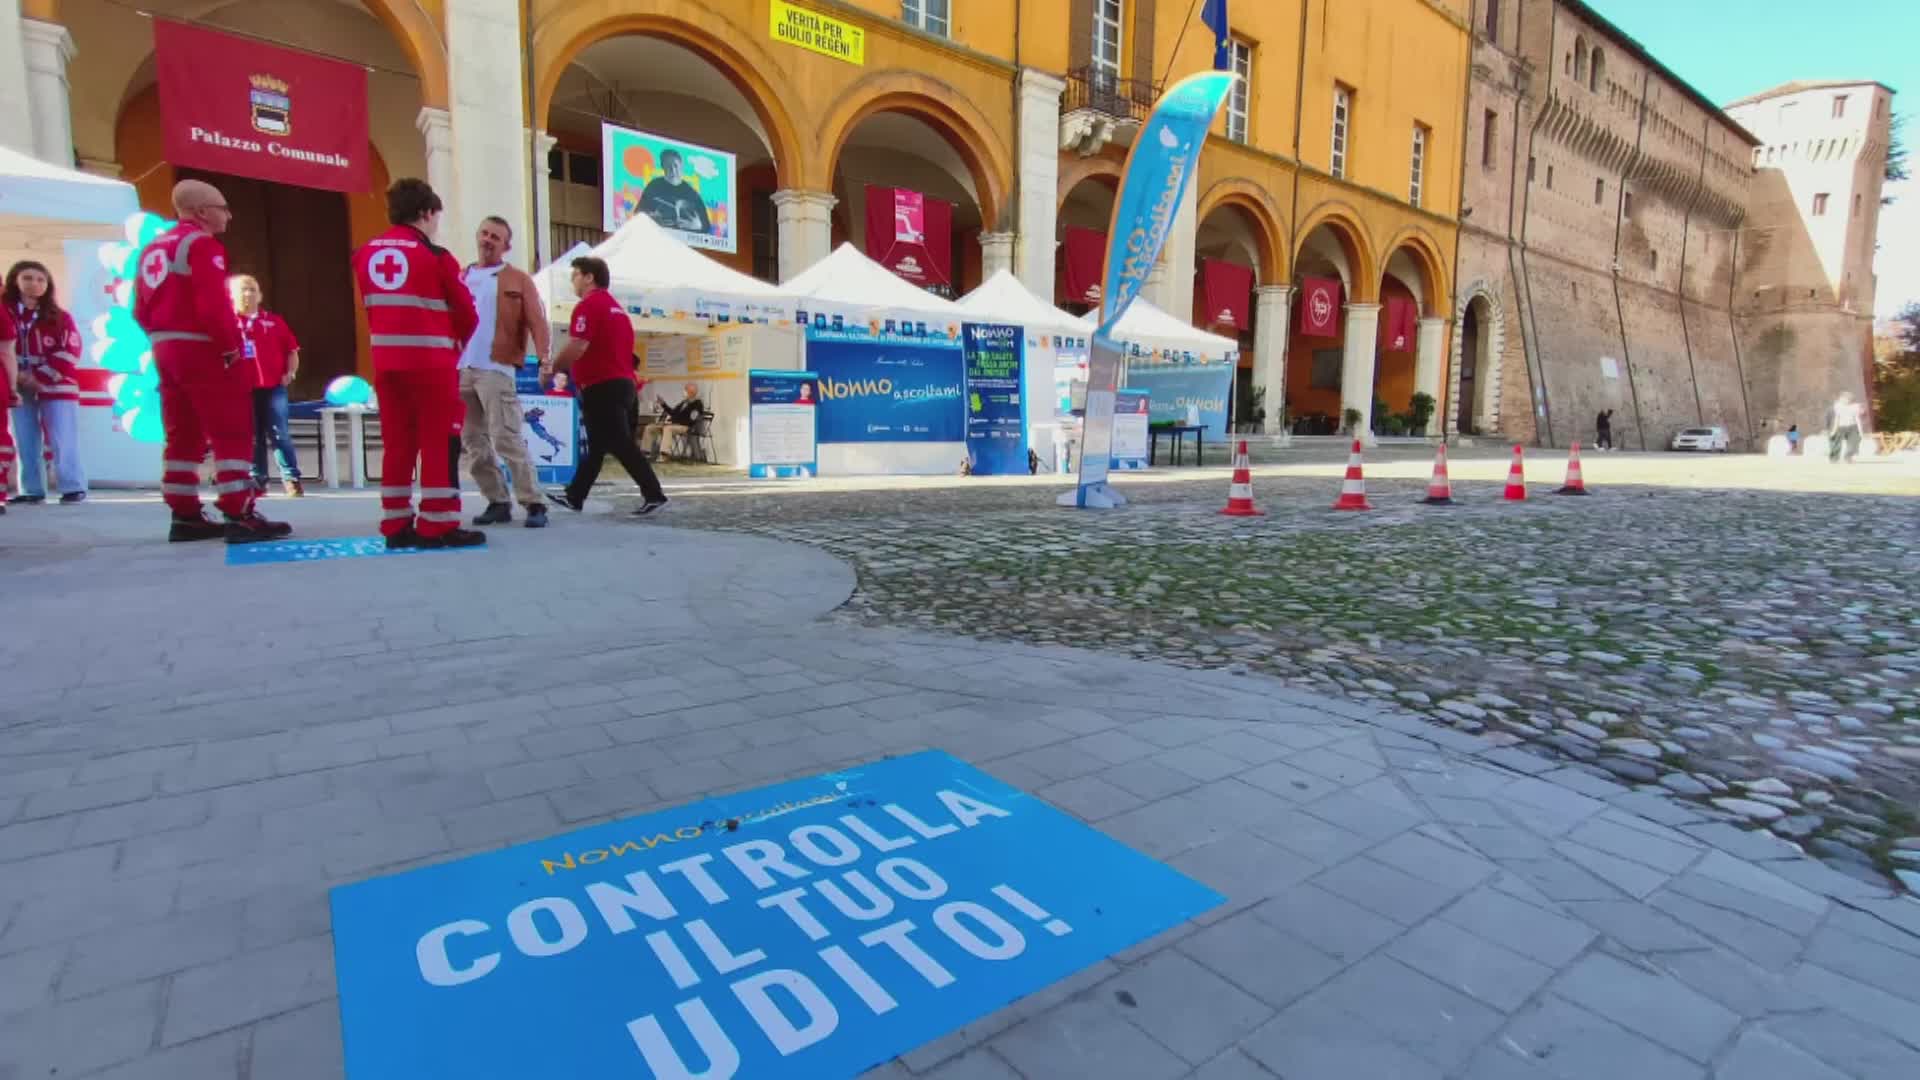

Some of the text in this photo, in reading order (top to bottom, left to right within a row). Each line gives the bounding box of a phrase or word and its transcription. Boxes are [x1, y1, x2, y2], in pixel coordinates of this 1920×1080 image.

[778, 23, 812, 44] GIULIO
[815, 34, 850, 56] REGENI
[786, 8, 842, 39] VERITÀ PER
[191, 127, 349, 167] Palazzo Comunale
[971, 326, 1014, 340] Nonno
[817, 376, 892, 402] Nonno
[894, 384, 962, 401] ascoltami
[541, 826, 702, 875] Nonno
[416, 790, 1013, 986] CONTROLLA
[645, 857, 949, 990] IL TUO
[626, 884, 1074, 1080] UDITO!
